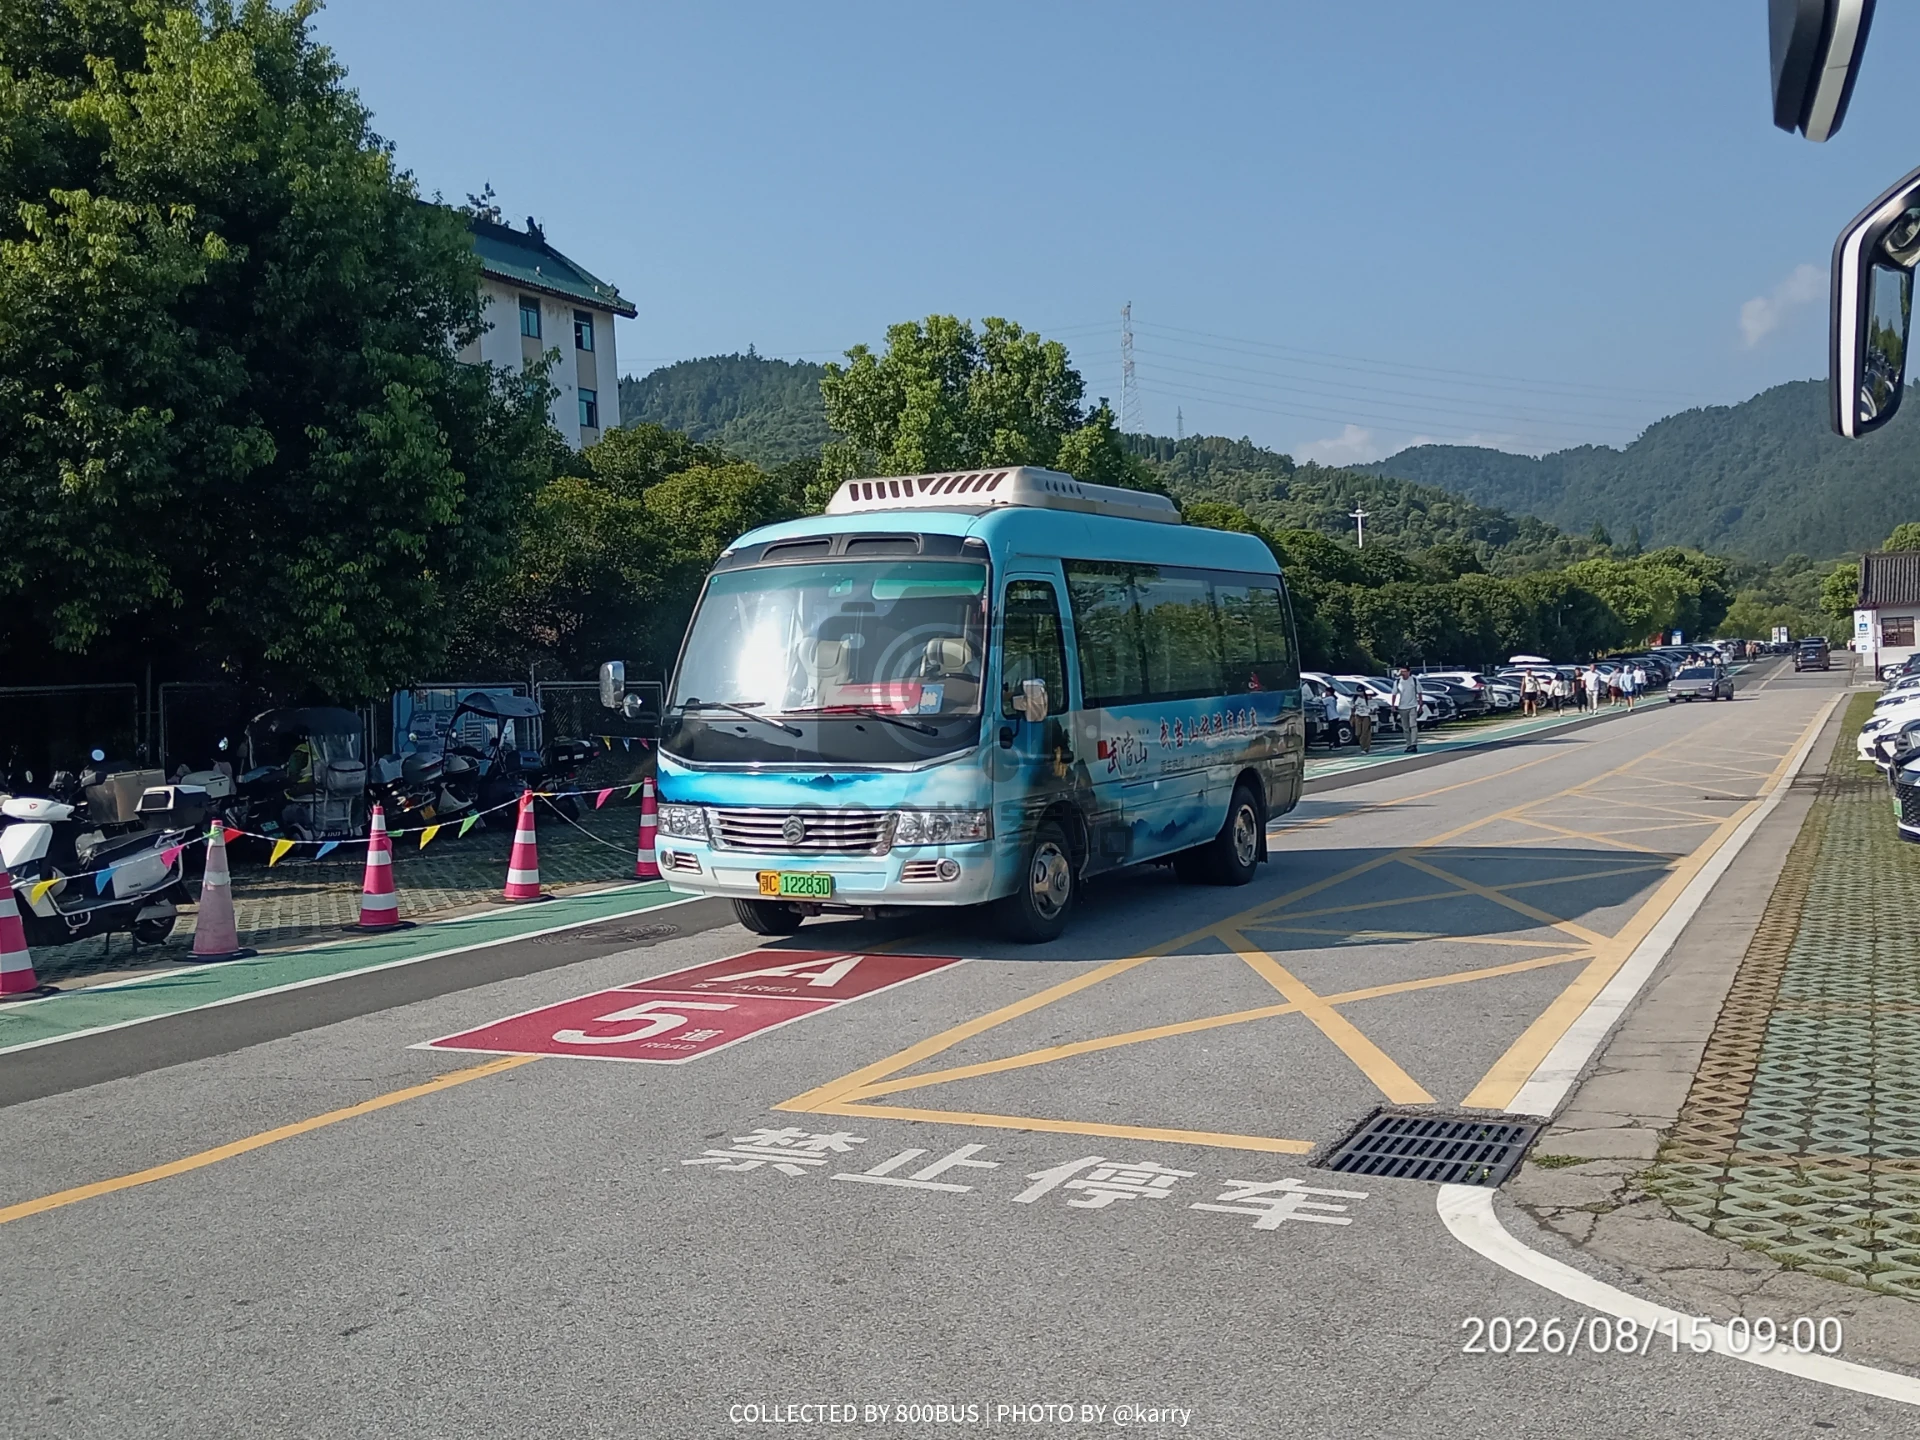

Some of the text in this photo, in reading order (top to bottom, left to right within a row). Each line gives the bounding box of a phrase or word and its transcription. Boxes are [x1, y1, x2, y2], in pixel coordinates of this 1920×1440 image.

[783, 876, 830, 895] 12283D
[704, 955, 865, 987] A
[731, 984, 798, 993] AREA
[552, 1000, 739, 1045] 5
[671, 1028, 724, 1042] 道
[640, 1042, 697, 1051] ROAD
[680, 1126, 1370, 1230] 禁止停车
